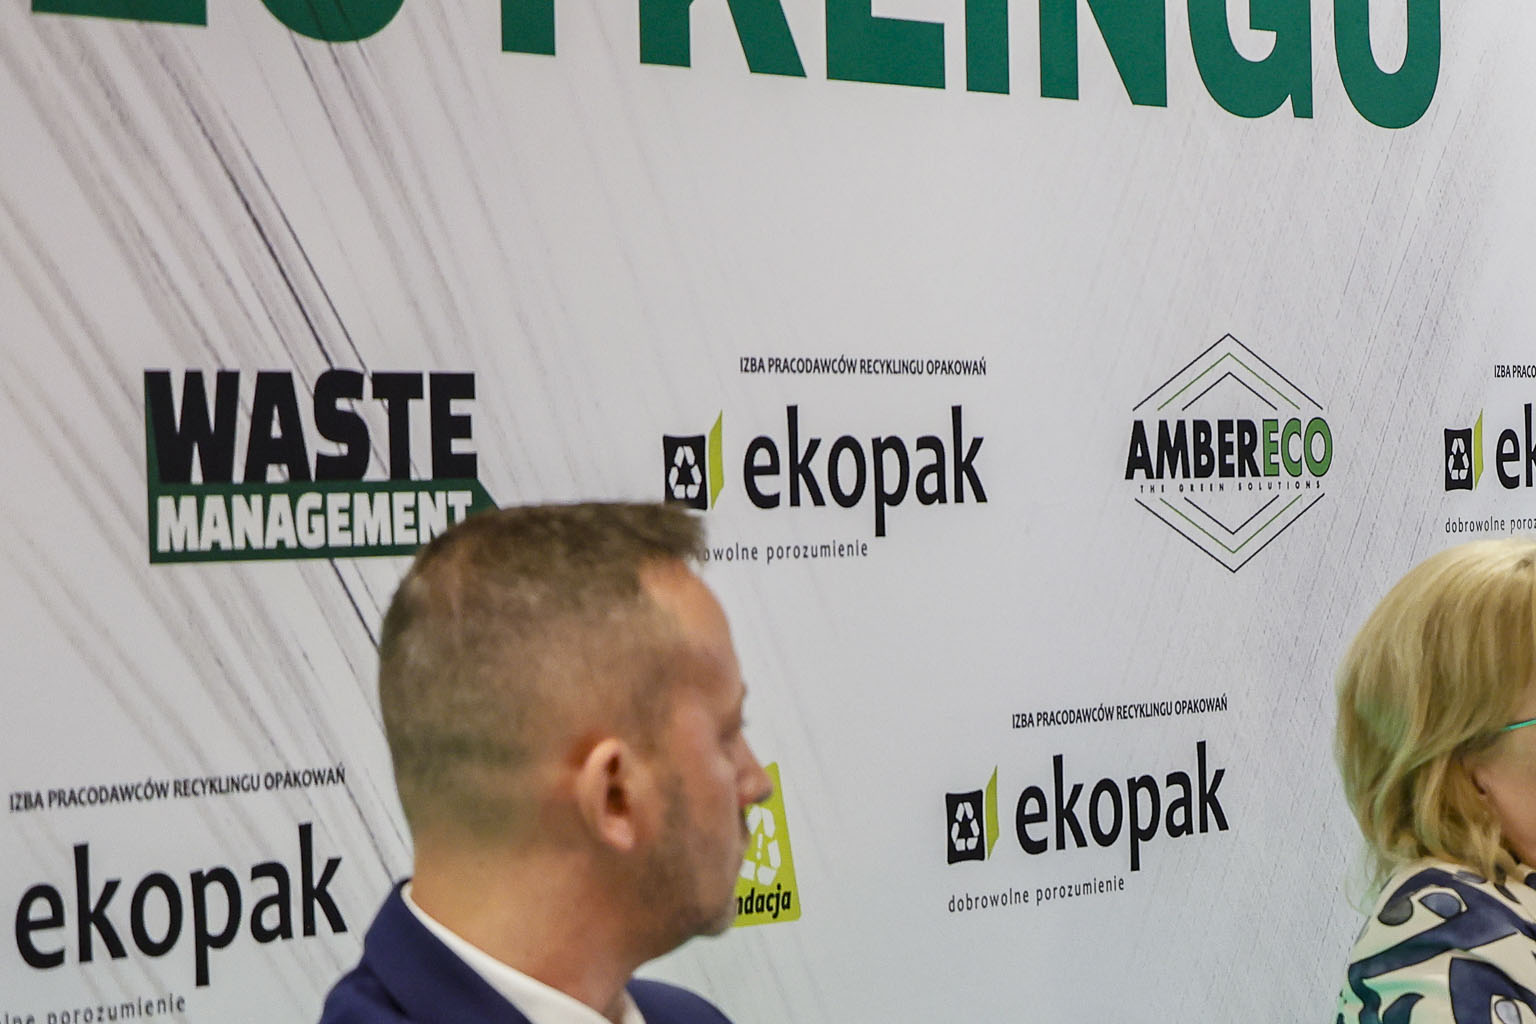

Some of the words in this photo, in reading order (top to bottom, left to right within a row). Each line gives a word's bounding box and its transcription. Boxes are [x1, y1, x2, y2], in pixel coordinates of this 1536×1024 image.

[739, 357, 766, 374] IZBA
[768, 354, 857, 375] PRACODAWCÓW
[860, 358, 924, 375] RECYKLINGU
[926, 356, 987, 375] OPAKOWAŃ
[1494, 364, 1511, 378] IZBA
[144, 369, 478, 484] WASTE
[1125, 417, 1333, 480] AMBERECO
[743, 405, 989, 537] ekopak
[1140, 484, 1165, 494] THE
[1238, 480, 1321, 491] SOLUTIONS
[157, 490, 473, 553] MANAGEMENT
[1445, 516, 1506, 533] dobrowolne
[766, 539, 869, 564] porozumienie
[1012, 713, 1035, 729] IZBA
[1037, 703, 1114, 728] PRACODAWCÓW
[1116, 700, 1173, 720] RECYKLINGU
[1174, 693, 1228, 716] OPAKOWAŃ
[10, 792, 45, 813] IZBA
[48, 777, 170, 809] PRACODAWCÓW
[173, 774, 261, 798] RECYKLINGU
[264, 761, 346, 791] OPAKOWAŃ
[1016, 740, 1229, 872] ekopak
[15, 822, 348, 988] ekopak
[948, 888, 1030, 912] dobrowolne
[1036, 875, 1125, 906] porozumienie
